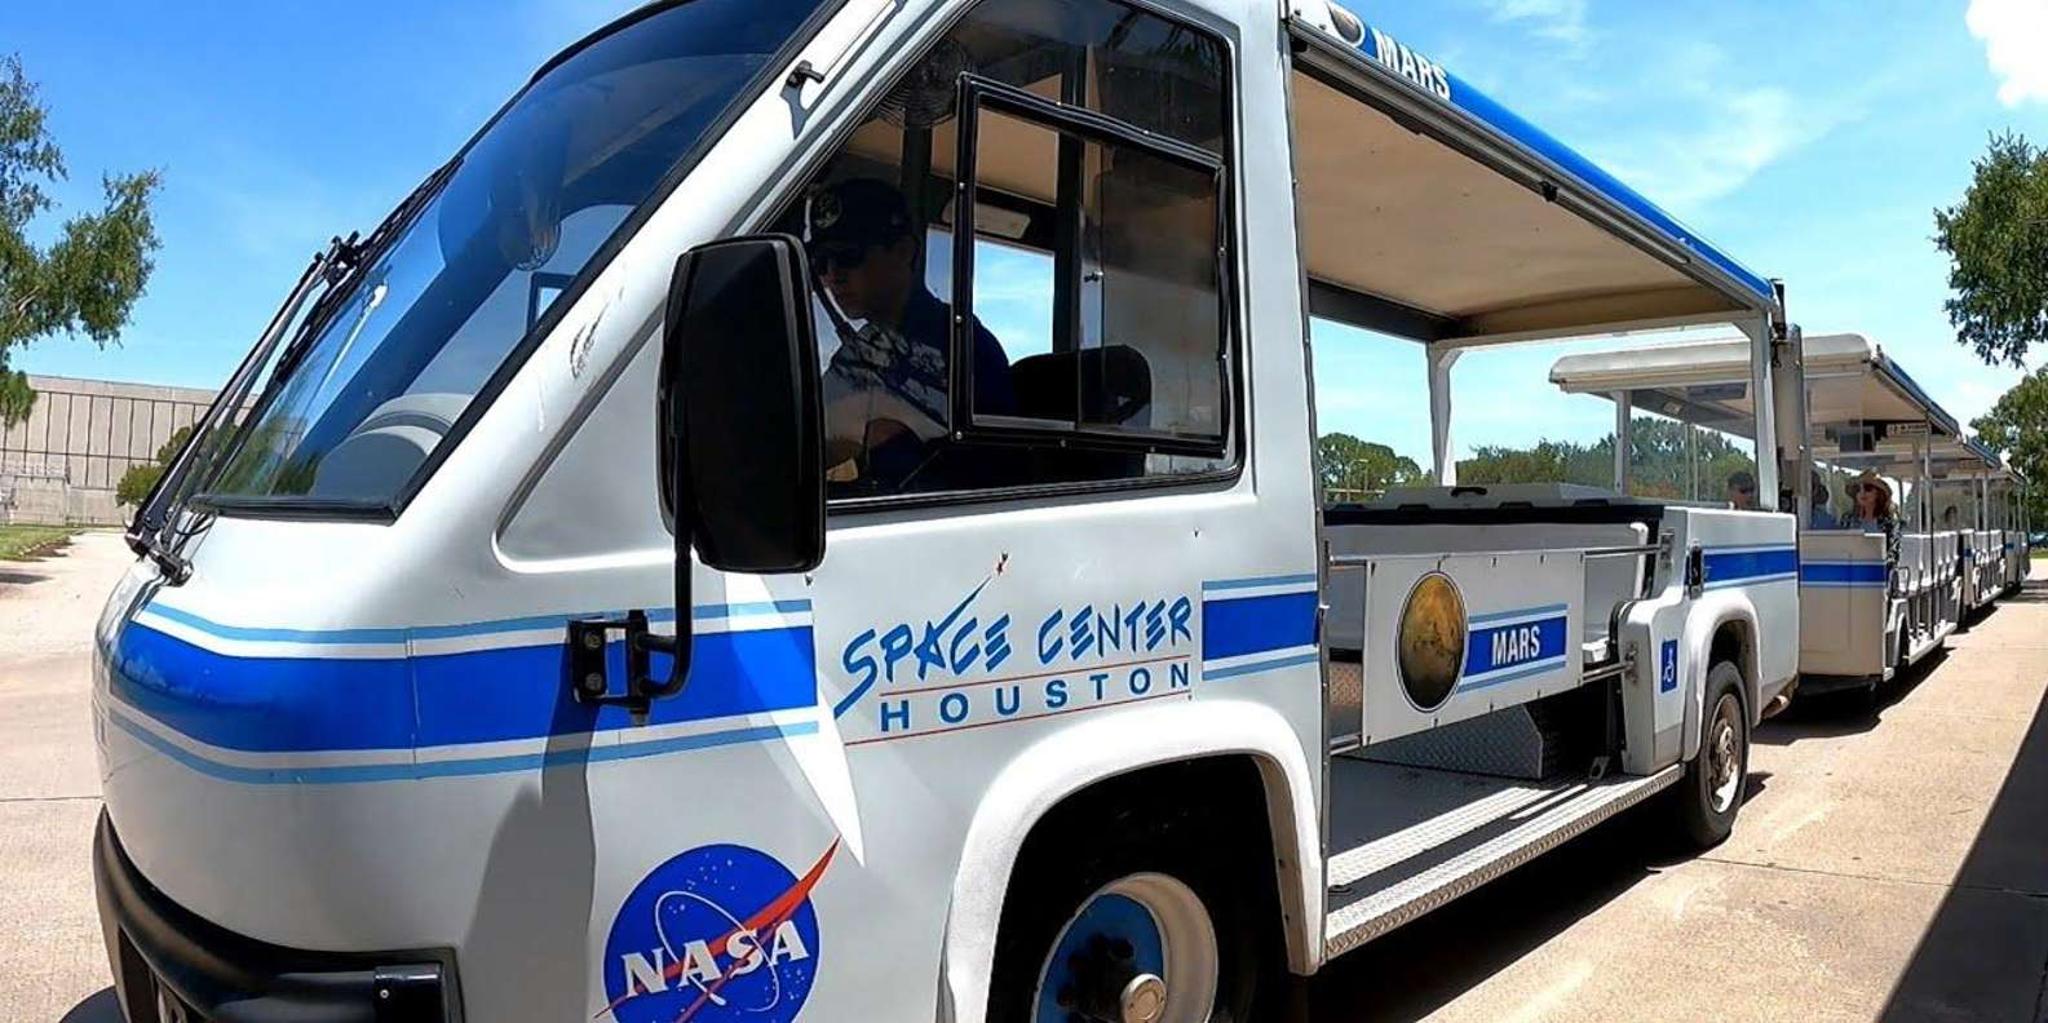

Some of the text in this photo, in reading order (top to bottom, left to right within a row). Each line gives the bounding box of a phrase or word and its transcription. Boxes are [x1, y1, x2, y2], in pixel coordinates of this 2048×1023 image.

[1371, 28, 1450, 100] MARS
[833, 575, 1193, 719] SPACE CENTER
[1491, 625, 1541, 667] MARS
[880, 662, 1190, 733] HOUSTON
[620, 920, 810, 998] NASA
